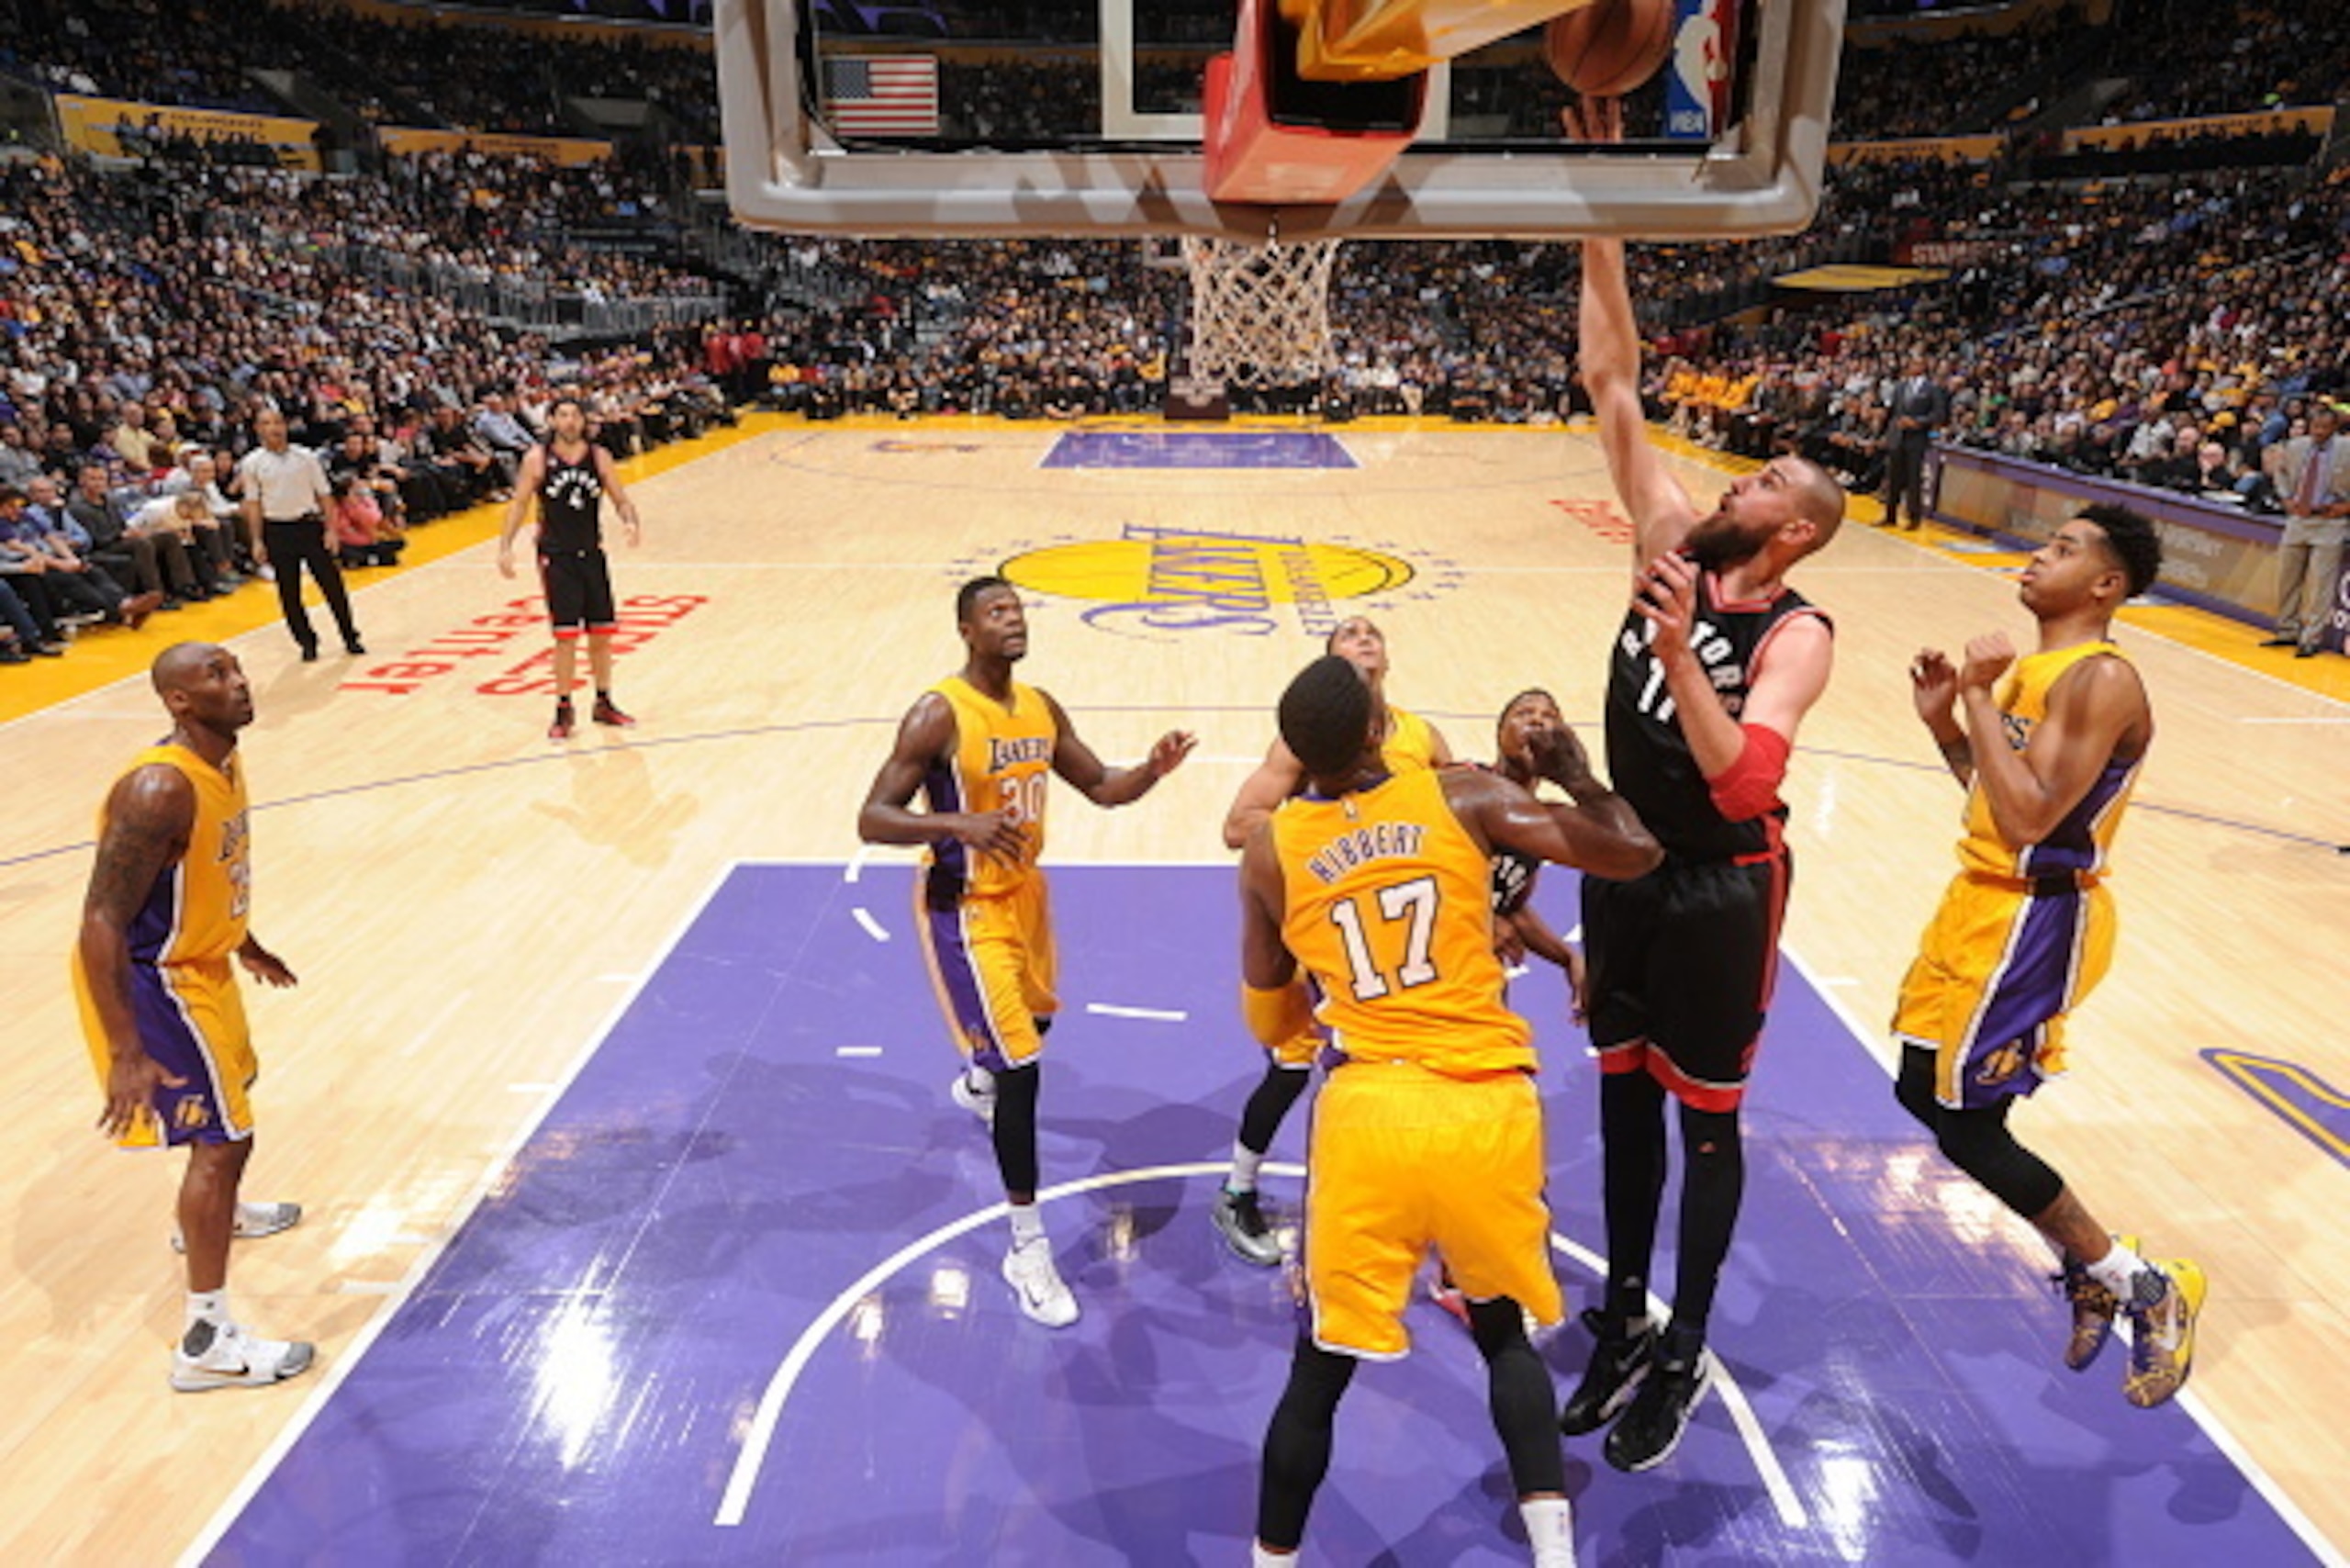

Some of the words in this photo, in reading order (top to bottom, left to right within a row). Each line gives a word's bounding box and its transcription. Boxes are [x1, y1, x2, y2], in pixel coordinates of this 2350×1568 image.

[568, 486, 586, 510] 4
[1001, 772, 1046, 827] 30
[1307, 824, 1425, 883] HIBBERT
[1330, 875, 1439, 1003] 17
